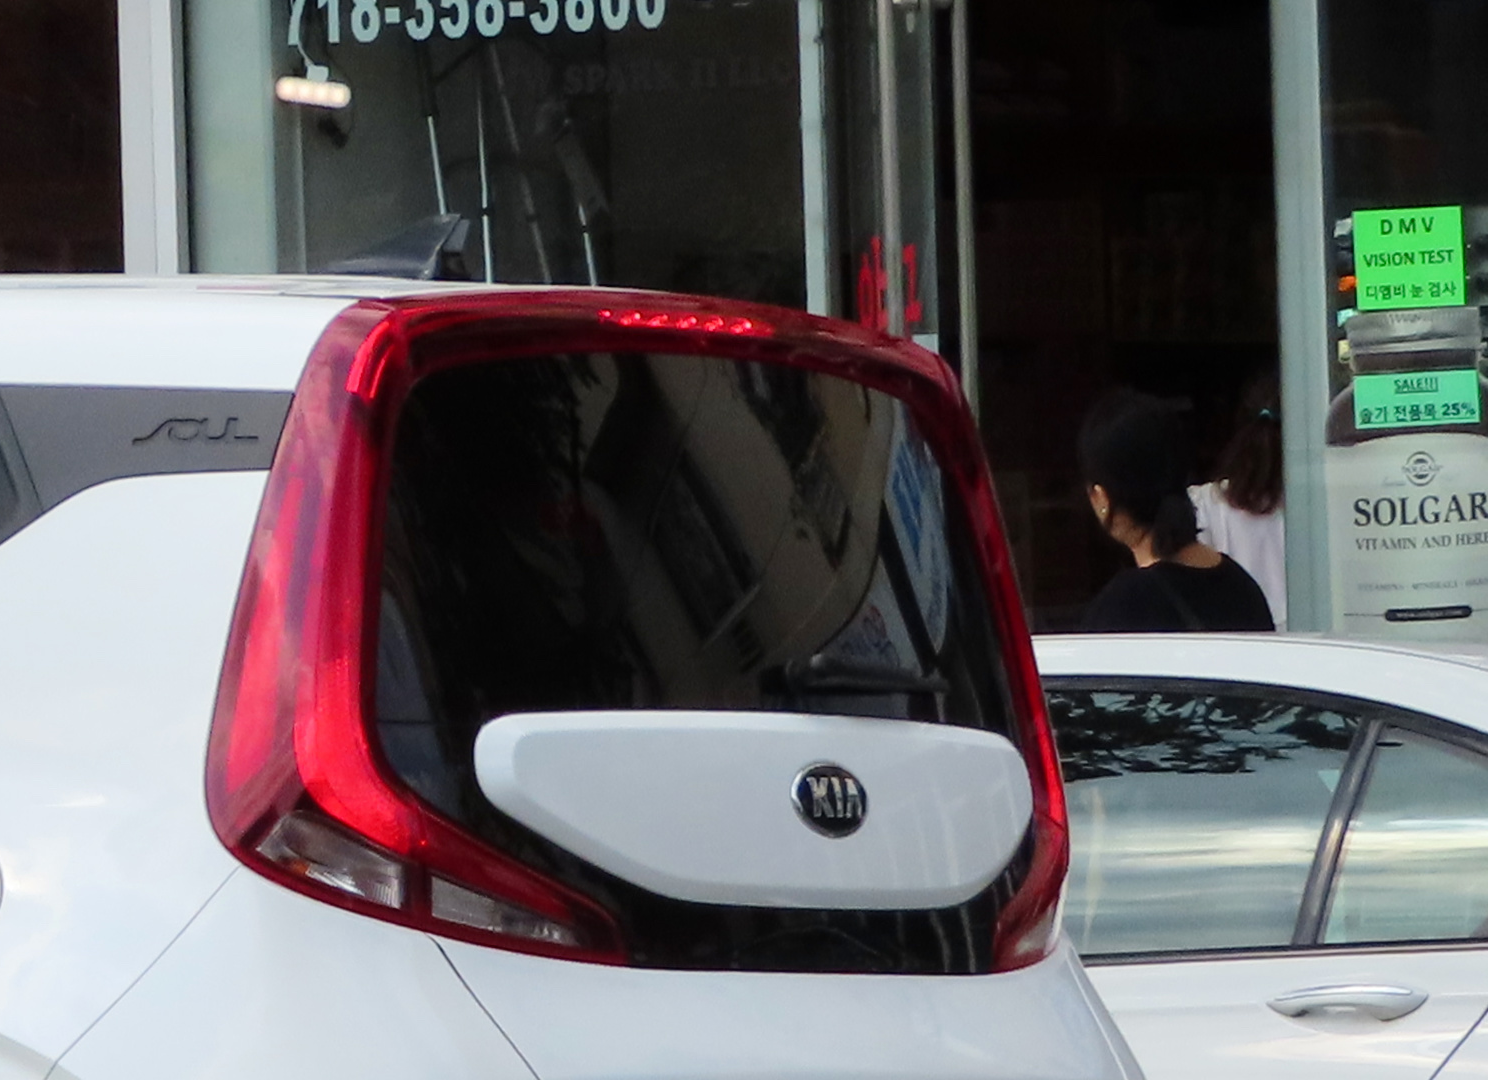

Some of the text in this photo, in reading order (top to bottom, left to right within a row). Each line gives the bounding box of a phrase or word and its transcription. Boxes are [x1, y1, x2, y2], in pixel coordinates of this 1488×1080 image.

[1363, 249, 1455, 268] VISION TEST
[1441, 402, 1476, 416] 25%
[1353, 492, 1488, 527] SOLGAR
[1355, 537, 1417, 551] VITAMIN
[1420, 535, 1452, 549] AND
[805, 776, 864, 819] KIA
